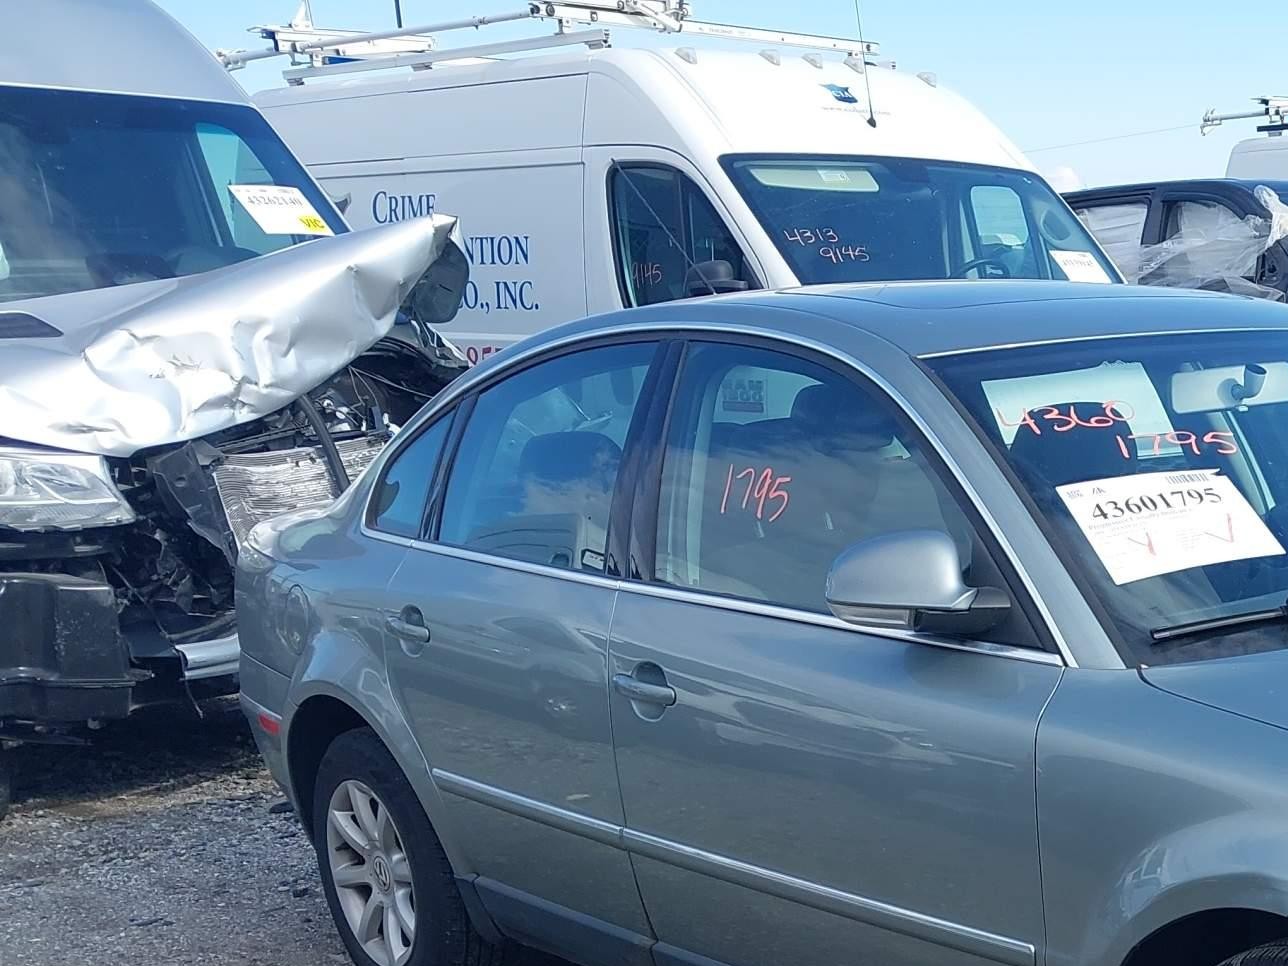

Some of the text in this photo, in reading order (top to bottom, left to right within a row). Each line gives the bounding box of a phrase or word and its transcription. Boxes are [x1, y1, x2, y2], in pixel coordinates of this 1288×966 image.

[783, 227, 839, 247] 4313
[819, 245, 870, 264] 9145
[631, 261, 662, 290] 9145
[494, 280, 540, 311] INC.
[996, 400, 1136, 436] 4360
[1116, 430, 1238, 459] 1795
[720, 463, 792, 522] 1795
[1091, 486, 1223, 521] 43601795
